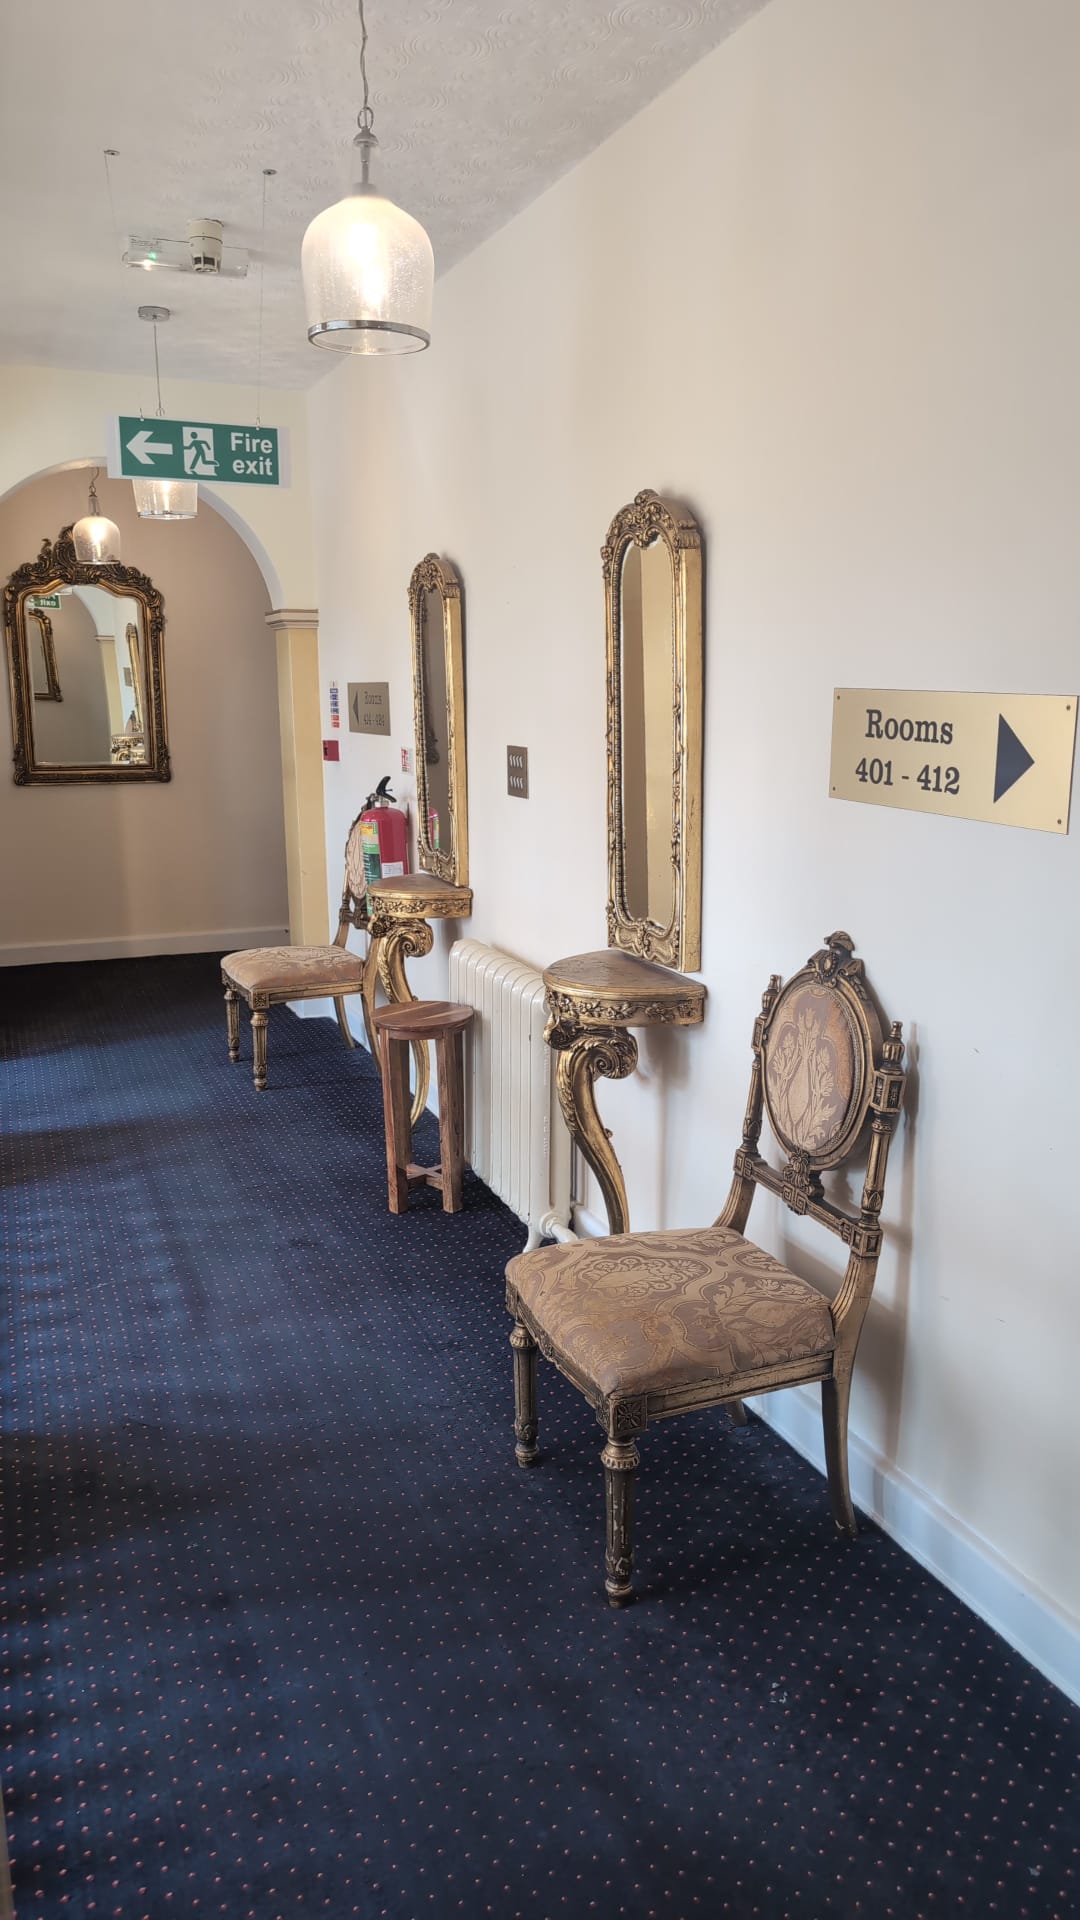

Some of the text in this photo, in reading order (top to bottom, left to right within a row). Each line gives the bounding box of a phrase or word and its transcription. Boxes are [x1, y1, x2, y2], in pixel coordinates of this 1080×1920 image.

[230, 432, 273, 454] Fire
[232, 457, 273, 476] exit
[865, 709, 953, 745] Rooms
[855, 757, 893, 786] 401
[916, 764, 960, 795] 412
